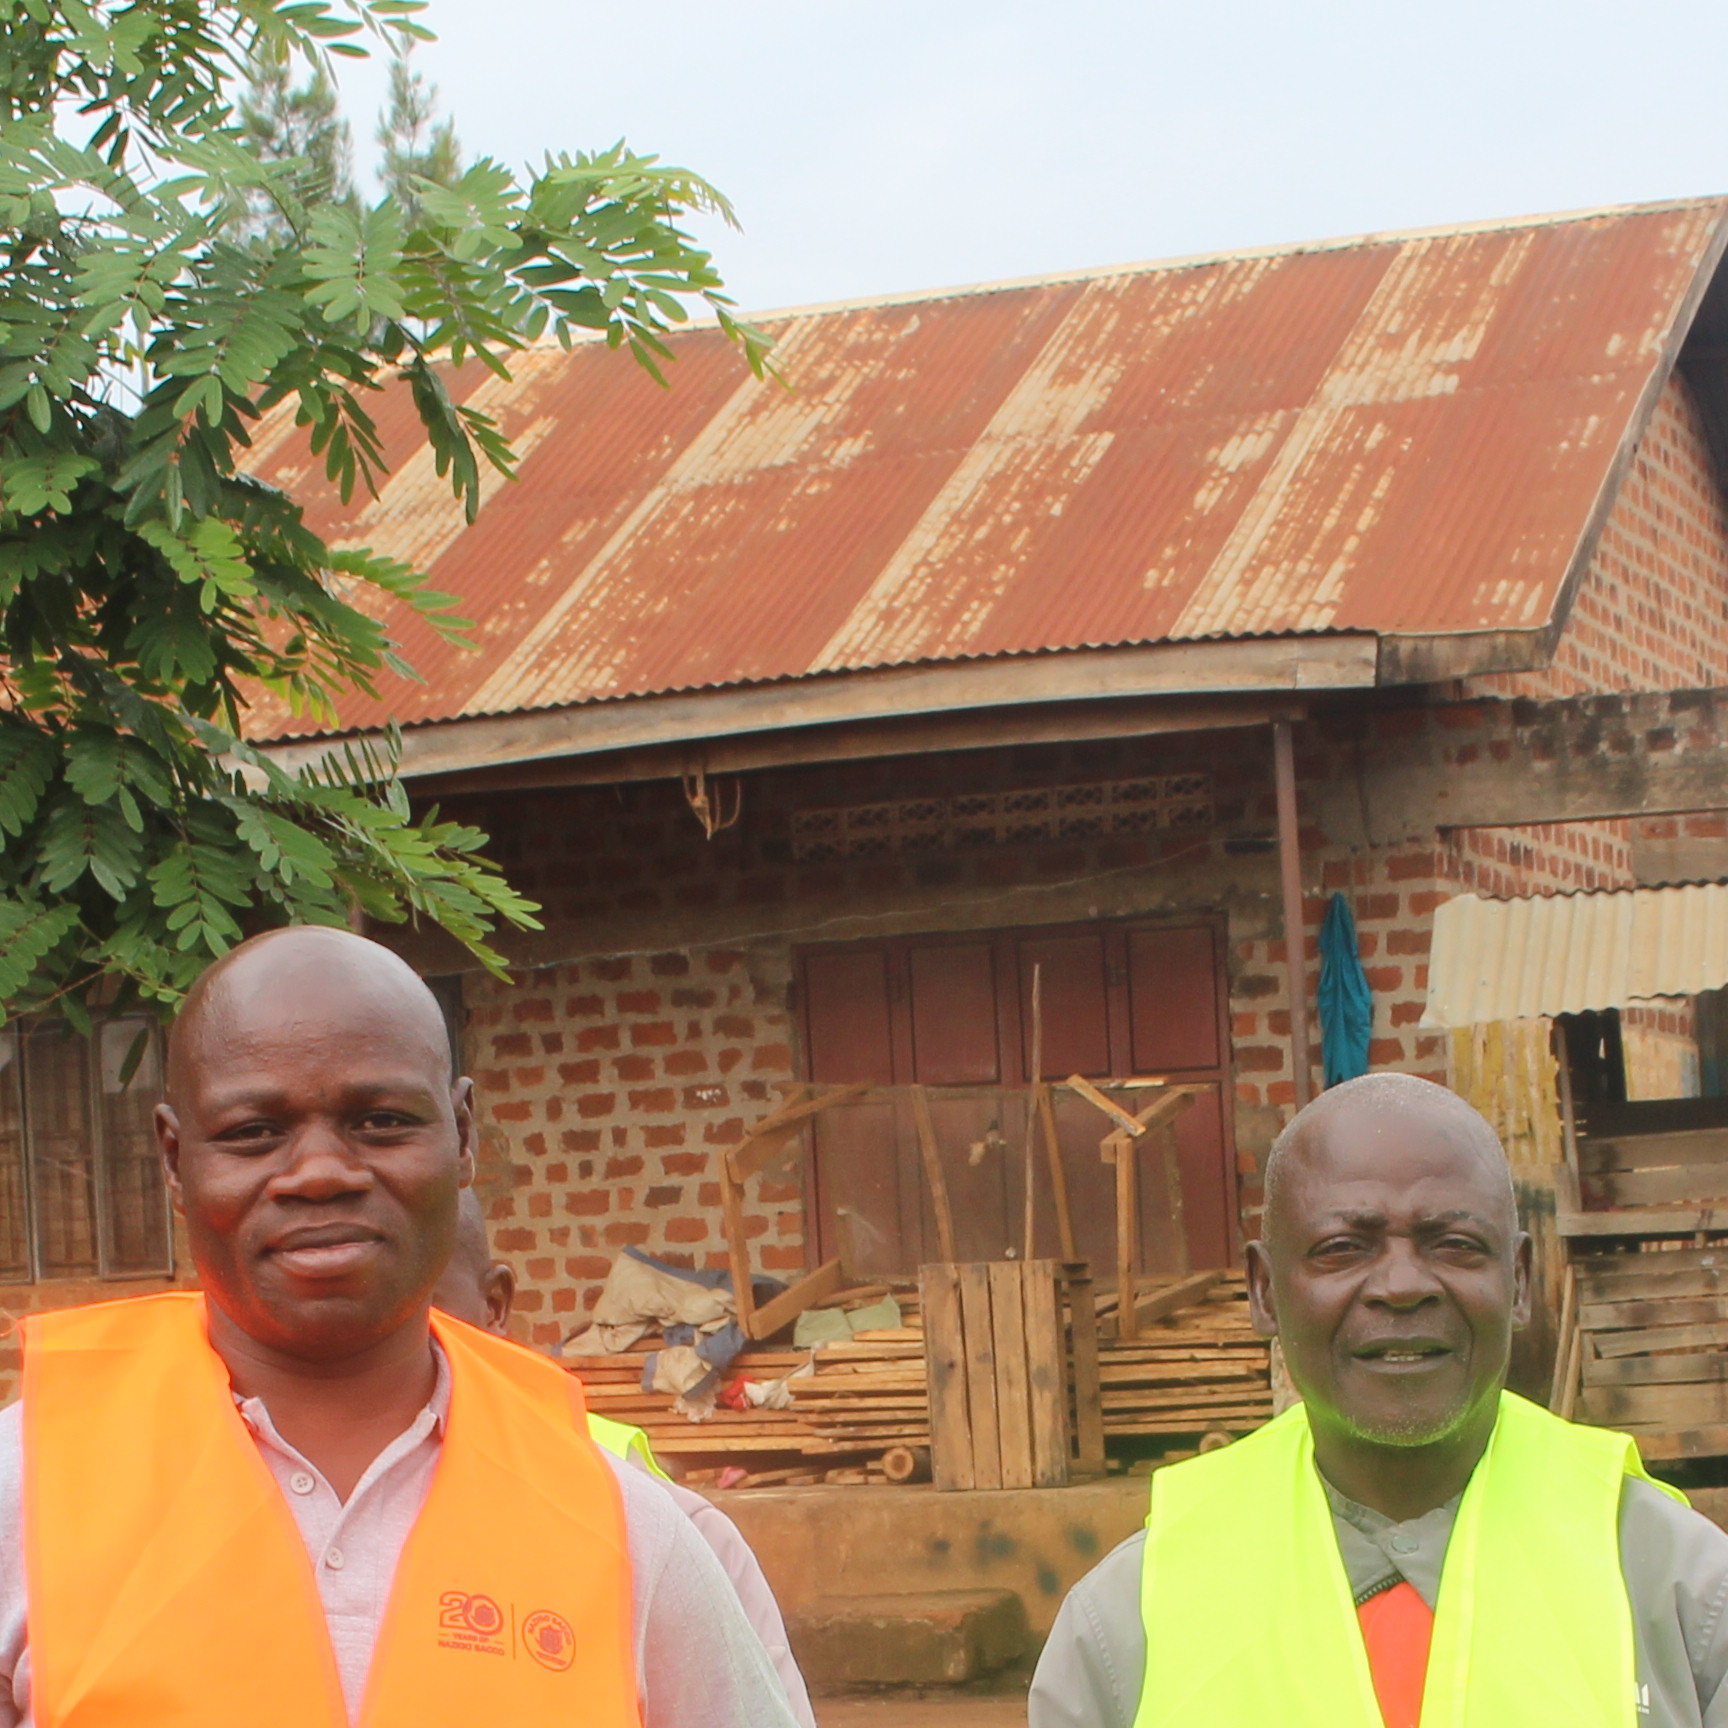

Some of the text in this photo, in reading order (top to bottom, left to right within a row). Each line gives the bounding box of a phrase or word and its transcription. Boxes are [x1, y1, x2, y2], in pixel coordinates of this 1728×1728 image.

[439, 1590, 504, 1637] 20
[528, 1614, 551, 1635] NAZIGO
[438, 1639, 505, 1656] NAZIGO SACCO
